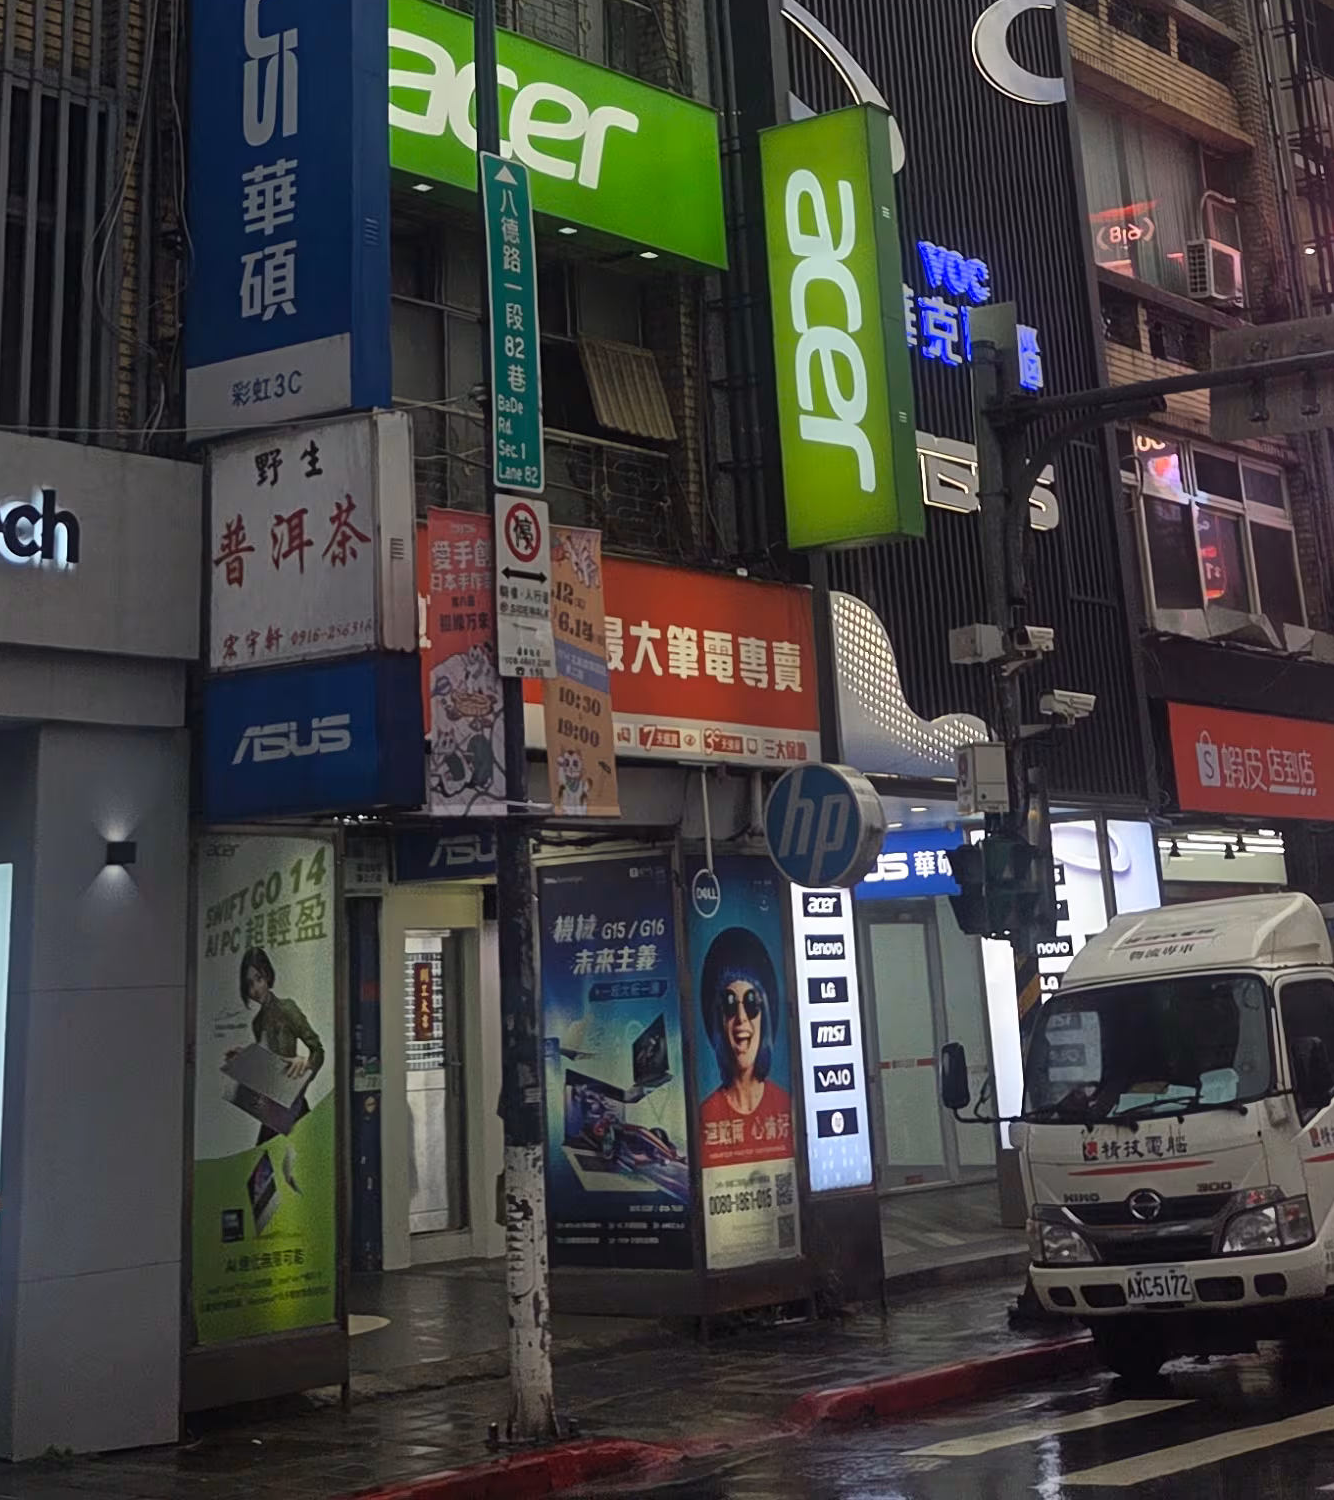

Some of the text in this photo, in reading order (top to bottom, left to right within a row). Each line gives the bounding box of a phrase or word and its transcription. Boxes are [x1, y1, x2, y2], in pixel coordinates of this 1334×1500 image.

[388, 27, 640, 190] acer
[239, 159, 299, 321] 華碩
[500, 188, 526, 394] 八德路一段82巷
[784, 167, 877, 493] acer
[231, 370, 303, 408] 彩虹3C
[497, 394, 524, 415] BaDe
[498, 416, 513, 435] Rd.
[255, 440, 323, 486] 野生
[498, 460, 539, 484] Lane 82
[213, 493, 372, 589] 普洱茶
[557, 686, 602, 717] 10:30
[231, 713, 351, 766] ASUS
[557, 717, 601, 748] 19:00
[1221, 743, 1268, 791] 蝦皮
[1267, 745, 1315, 785] 店到店
[777, 764, 851, 886] hp
[206, 843, 240, 857] acer
[429, 834, 497, 868] ASU
[205, 846, 327, 930] SWIFT GO 14
[696, 887, 718, 901] DELL
[807, 896, 837, 913] acer
[220, 926, 241, 956] PC
[602, 922, 627, 941] G15
[638, 918, 665, 937] G16
[573, 944, 659, 975] 未來主義
[807, 938, 843, 956] Lenovo
[1037, 941, 1070, 955] novo
[820, 982, 836, 999] LG
[1040, 975, 1059, 990] LG
[816, 1025, 846, 1043] msi
[818, 1069, 850, 1087] VAIO
[1101, 1134, 1189, 1159] 精技電腦
[1196, 1181, 1232, 1193] 300
